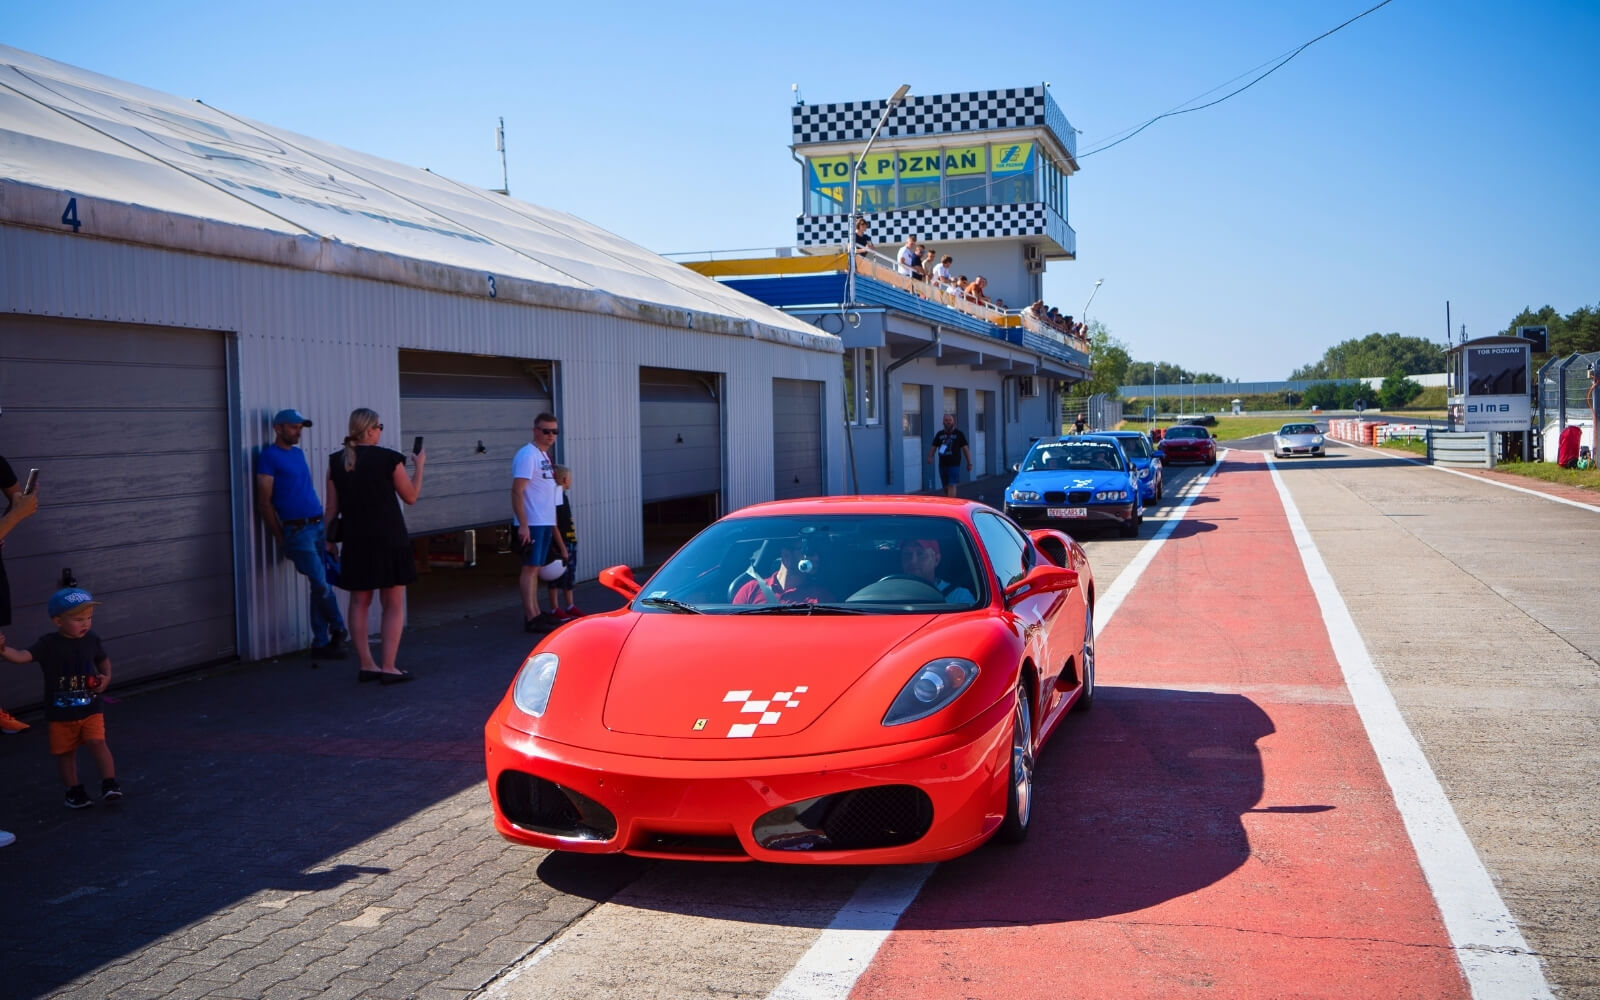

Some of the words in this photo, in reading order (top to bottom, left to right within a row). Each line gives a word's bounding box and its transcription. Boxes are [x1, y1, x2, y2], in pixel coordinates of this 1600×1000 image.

[877, 149, 977, 174] POZNAŃ
[61, 197, 82, 233] 4
[487, 275, 497, 298] 3
[687, 312, 693, 329] 2
[1467, 403, 1510, 413] alma
